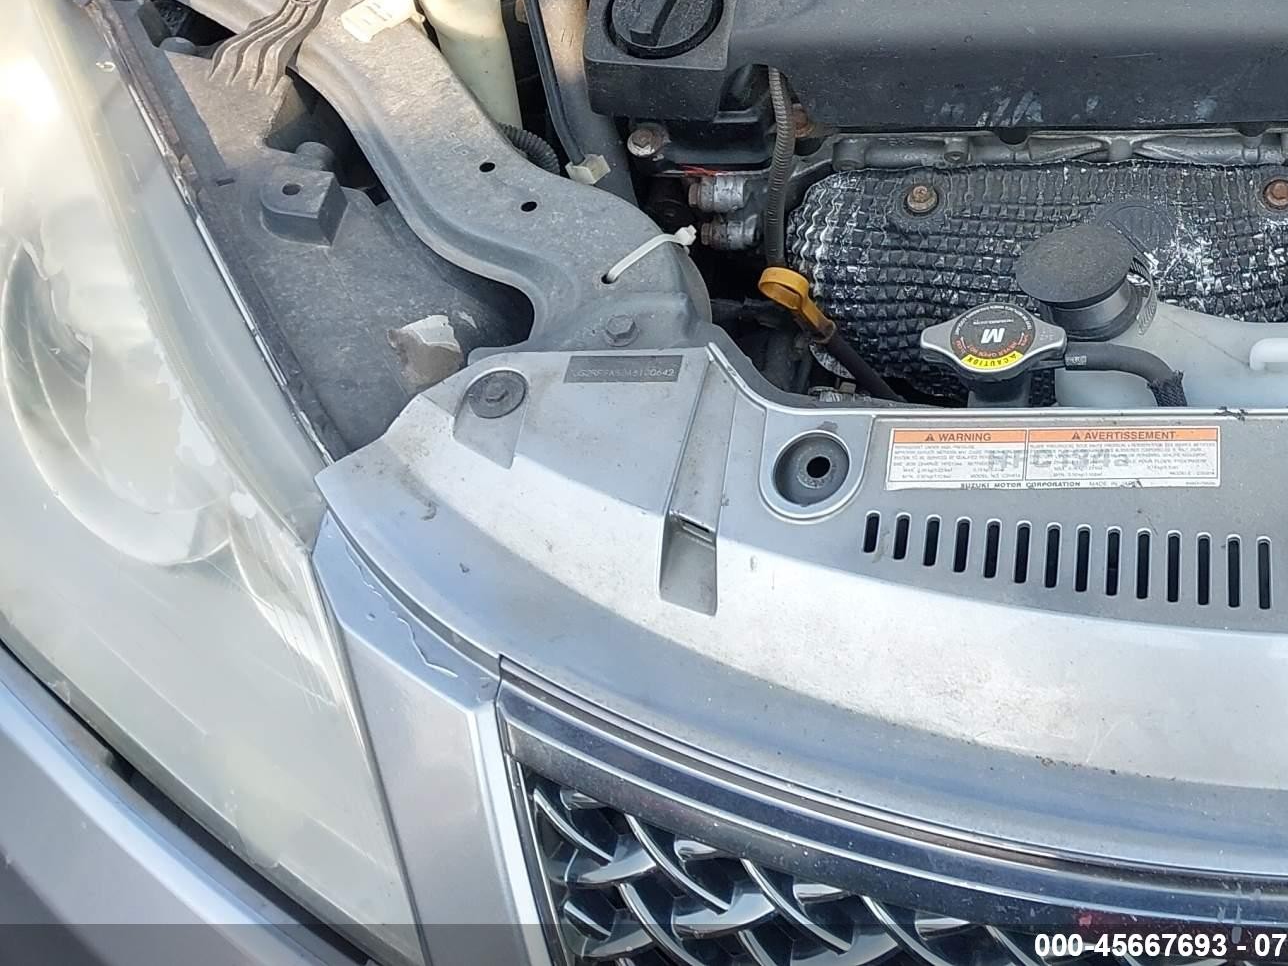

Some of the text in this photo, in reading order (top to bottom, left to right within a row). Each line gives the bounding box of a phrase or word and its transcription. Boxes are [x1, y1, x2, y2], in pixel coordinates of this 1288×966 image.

[981, 328, 1005, 344] M
[966, 355, 1010, 368] CAUTION
[938, 432, 992, 442] WARNING
[1084, 431, 1176, 441] AVERTISSEMENT
[960, 482, 990, 490] SUZUKI
[1026, 481, 1081, 489] CORPORATION
